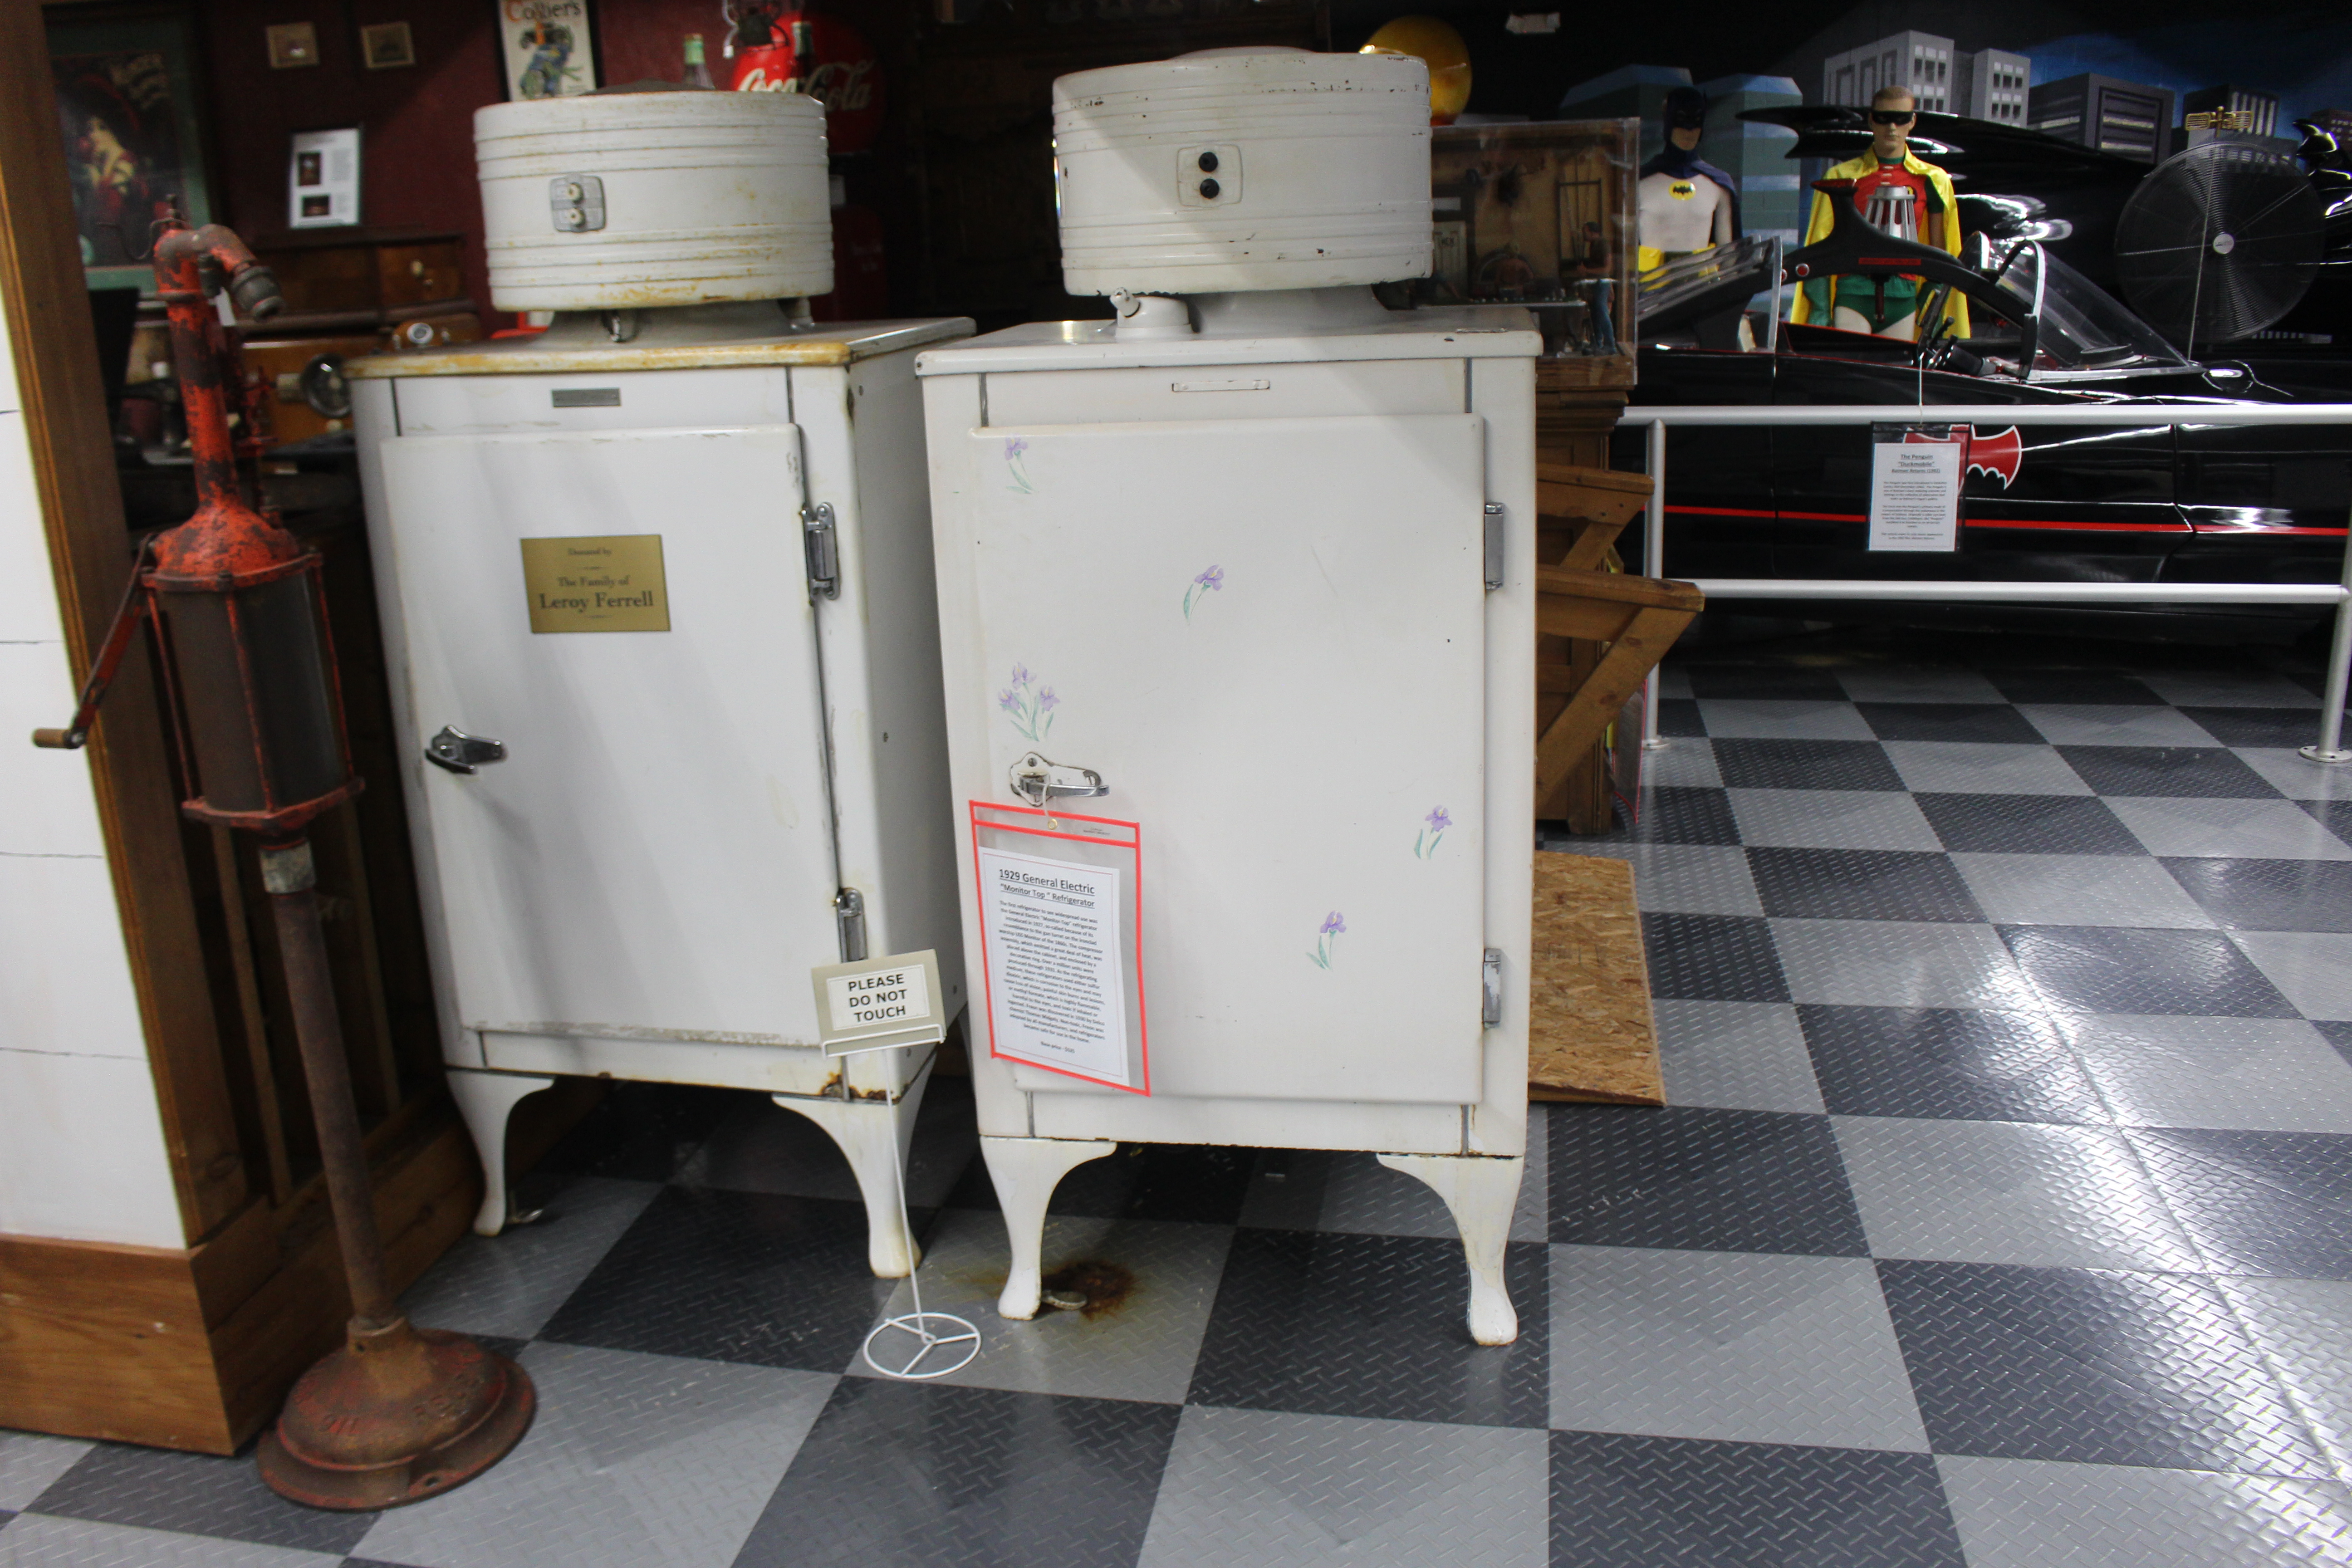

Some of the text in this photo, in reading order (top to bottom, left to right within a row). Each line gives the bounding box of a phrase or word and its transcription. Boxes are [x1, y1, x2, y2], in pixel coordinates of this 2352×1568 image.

[557, 575, 631, 588] The Family of
[539, 590, 654, 613] Leroy Ferrell
[1000, 869, 1094, 894] 1929 General Electric
[1033, 890, 1045, 899] Top
[1053, 893, 1094, 906] Refrigerator
[848, 974, 904, 991] PLEASE
[849, 989, 907, 1007] DO NOT
[854, 1005, 906, 1022] TOUCH
